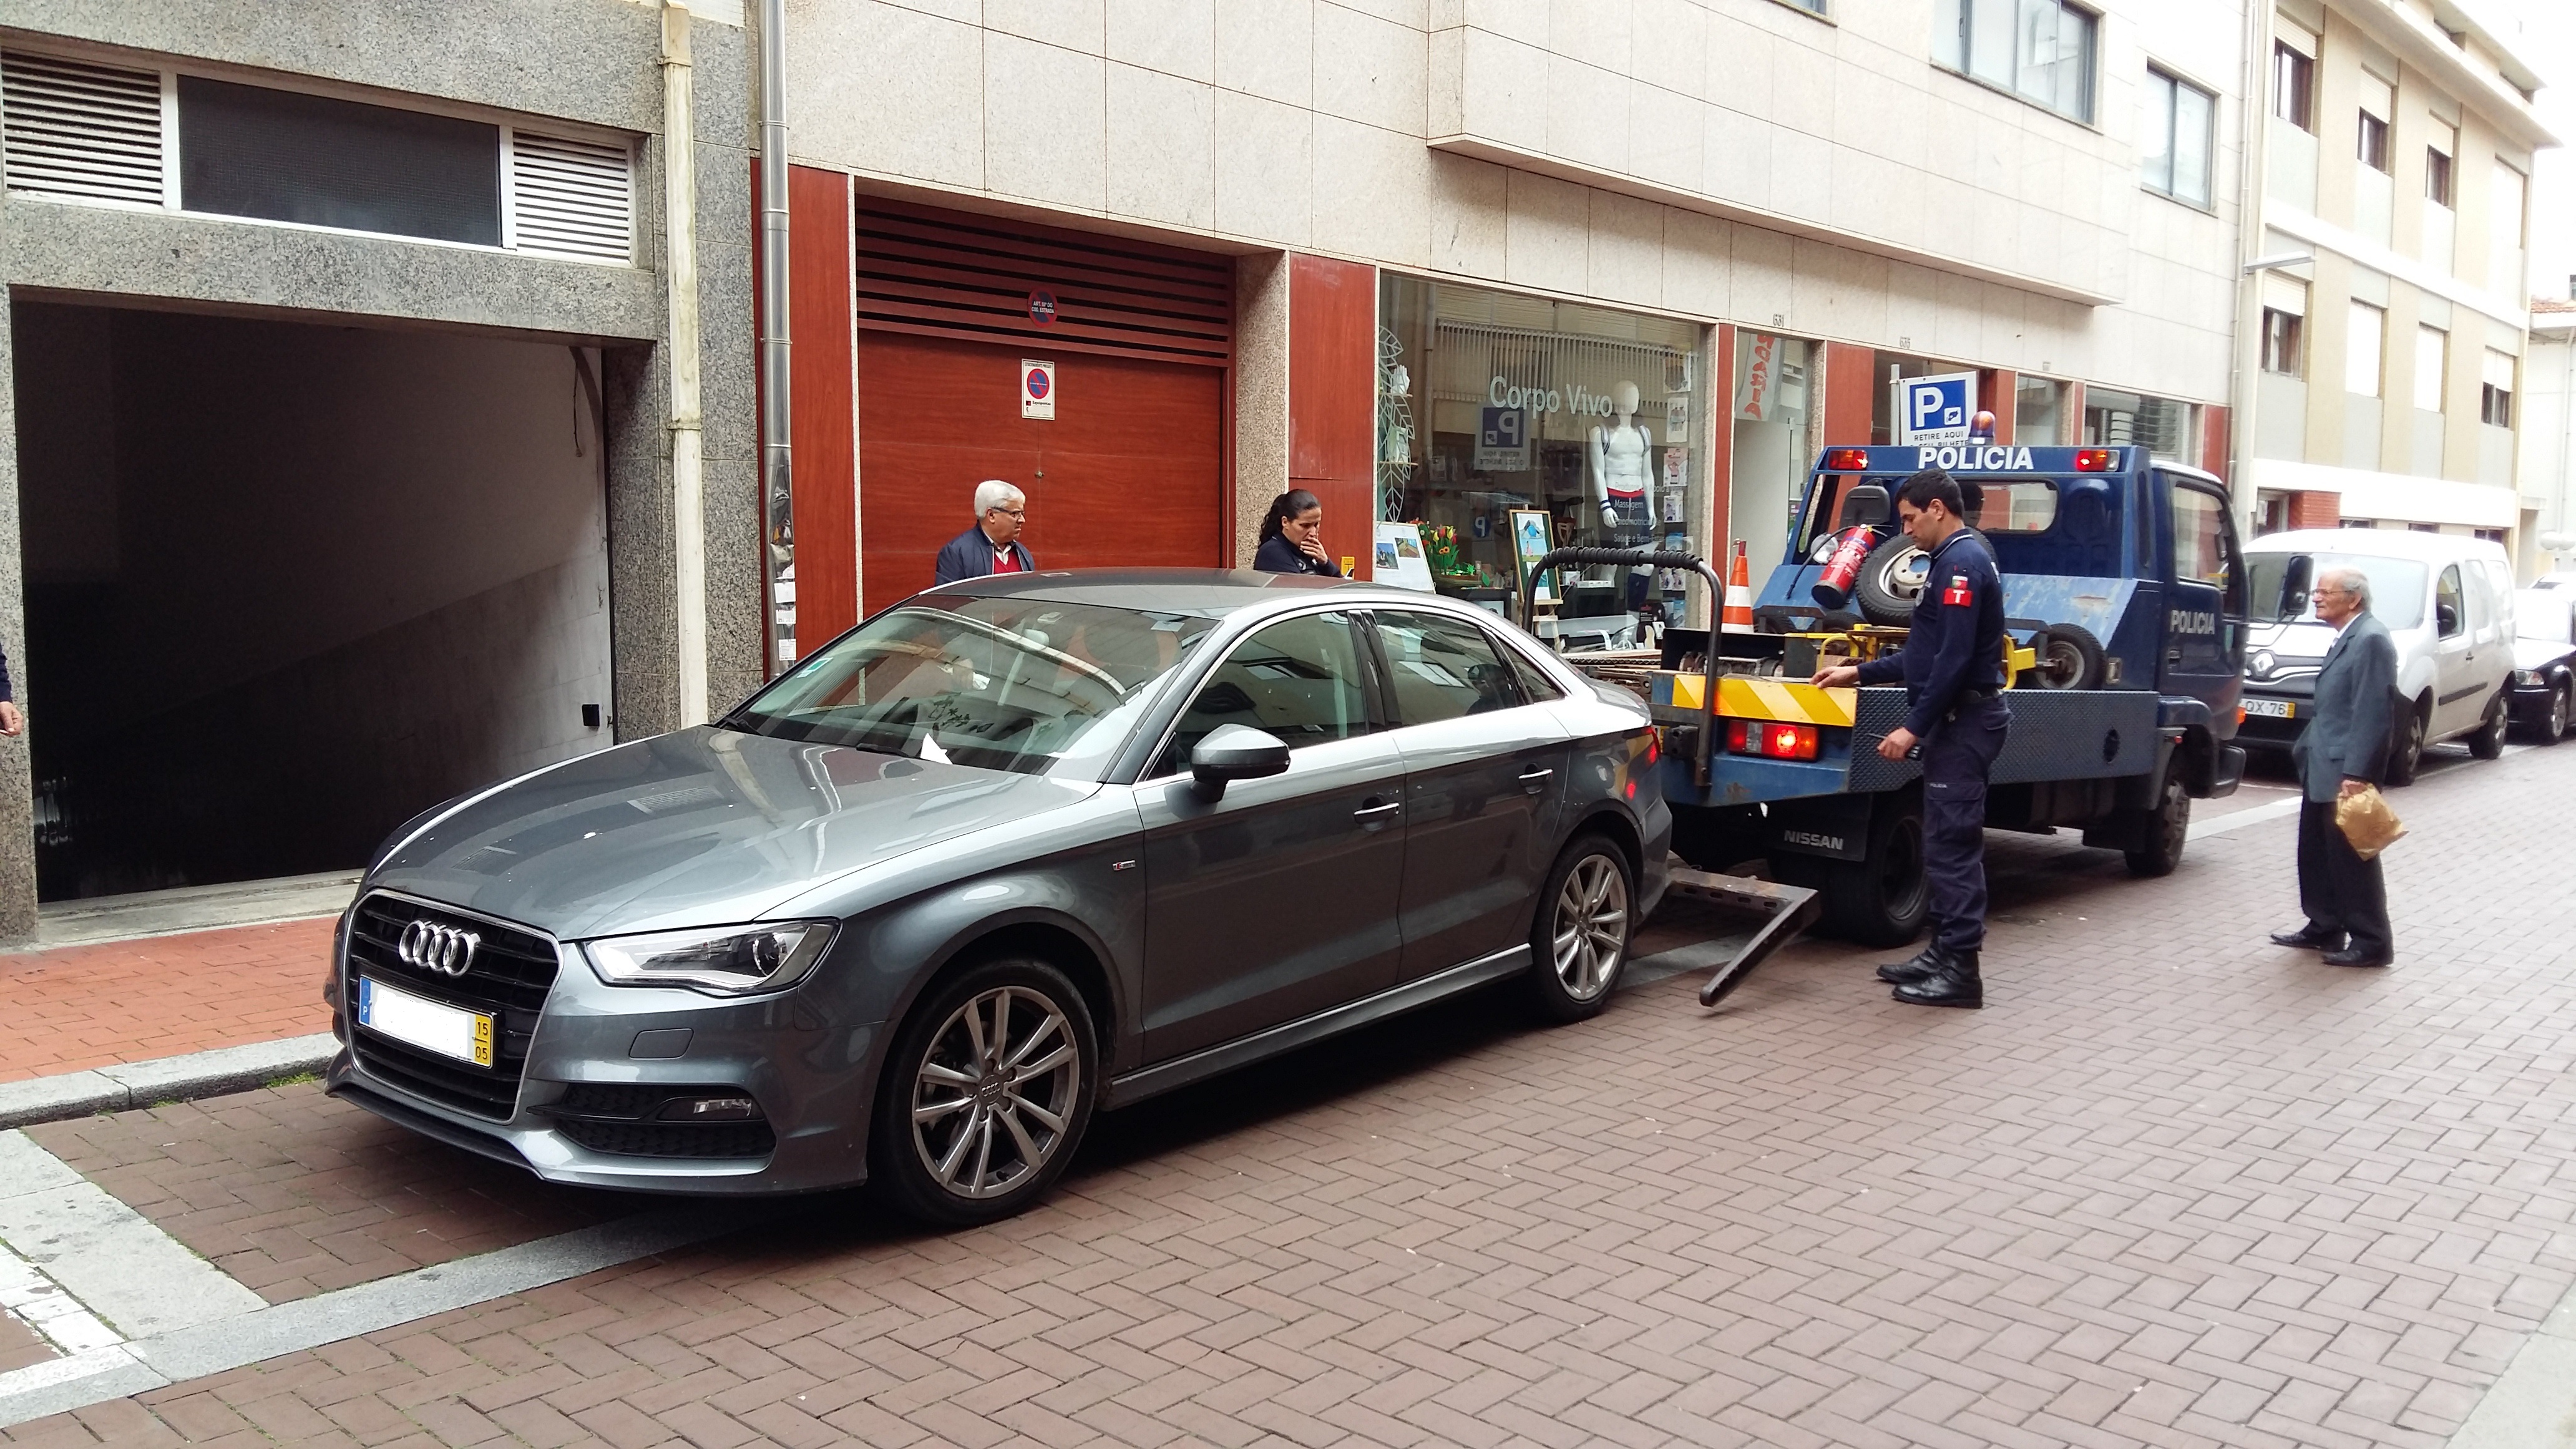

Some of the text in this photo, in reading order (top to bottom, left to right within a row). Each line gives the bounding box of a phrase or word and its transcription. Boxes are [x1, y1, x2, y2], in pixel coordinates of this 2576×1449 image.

[1772, 313, 1784, 327] 631
[1490, 376, 1613, 419] Corpo Vivo
[1915, 387, 1944, 427] P
[1914, 432, 1940, 441] RETIRE
[1918, 447, 2034, 470] POLICIA
[1953, 589, 1966, 603] T
[2169, 610, 2215, 635] POLICIA
[1785, 829, 1843, 851] NISSAN
[363, 1005, 368, 1015] P
[477, 1022, 488, 1036] 15
[476, 1046, 487, 1060] 05
